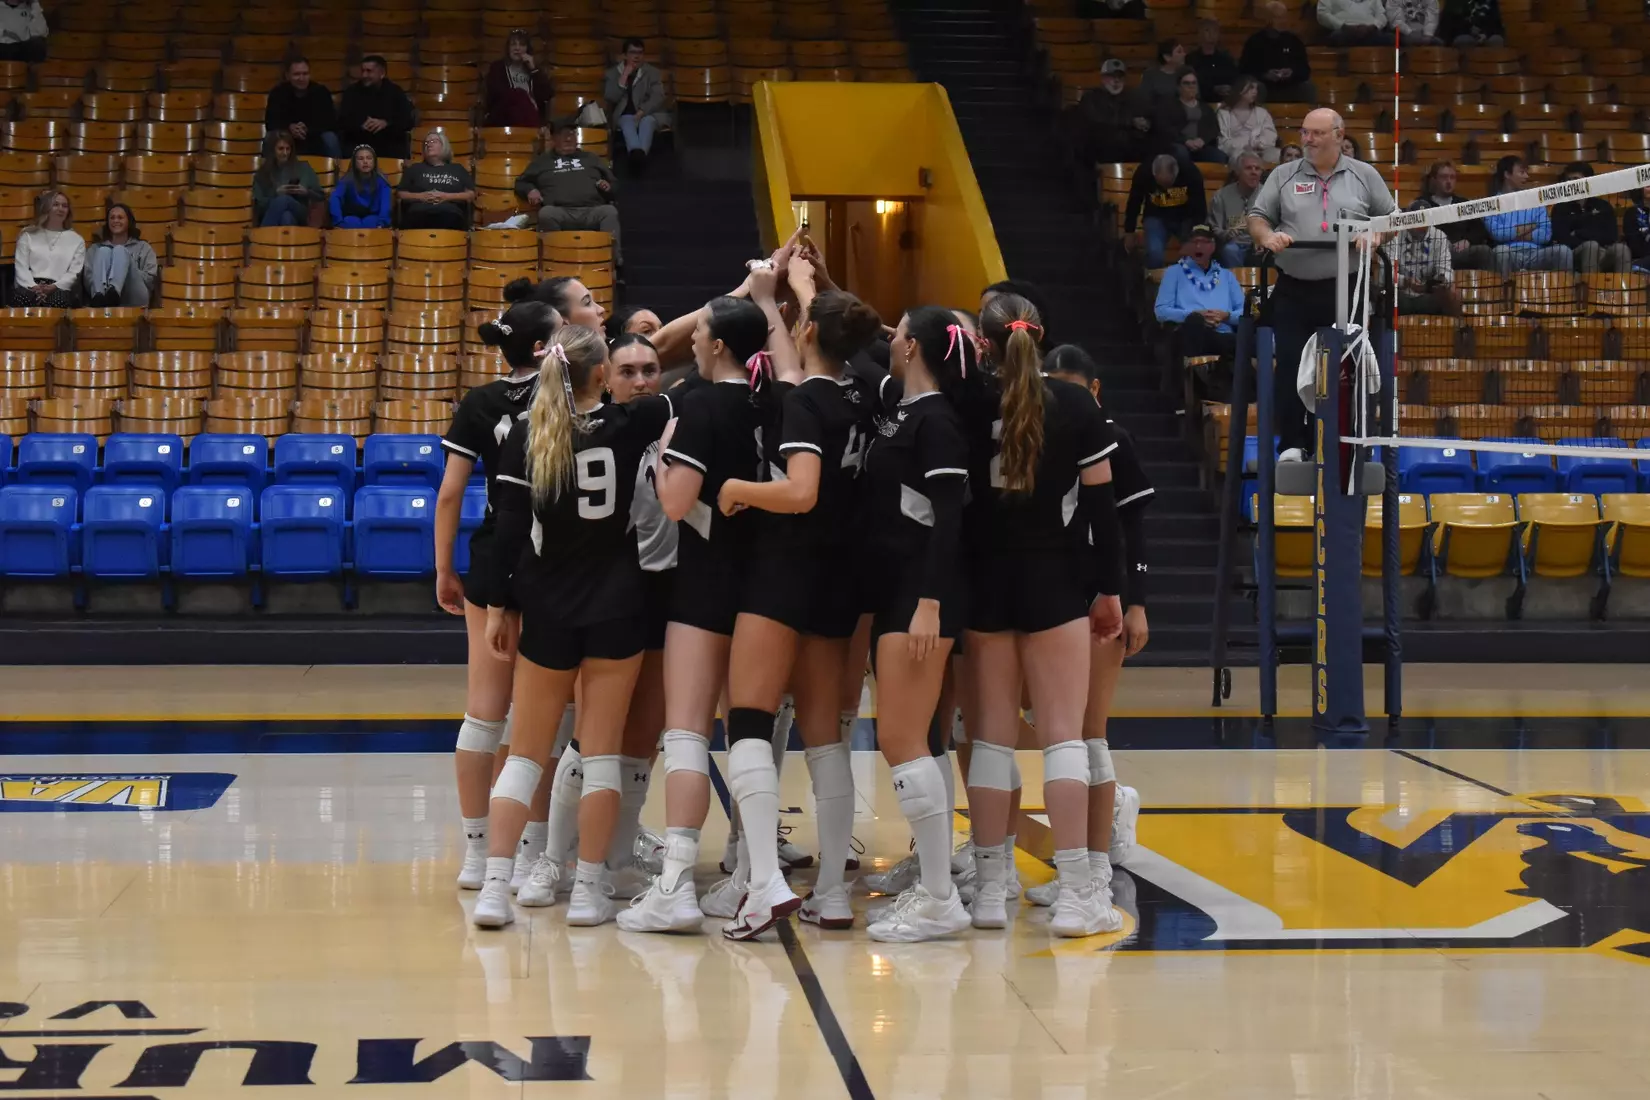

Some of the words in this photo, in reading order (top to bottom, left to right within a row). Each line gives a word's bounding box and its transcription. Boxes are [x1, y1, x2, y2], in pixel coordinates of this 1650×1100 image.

[1543, 187, 1557, 200] RACER
[1557, 182, 1585, 198] VOLLEYBALL
[575, 447, 616, 520] 9
